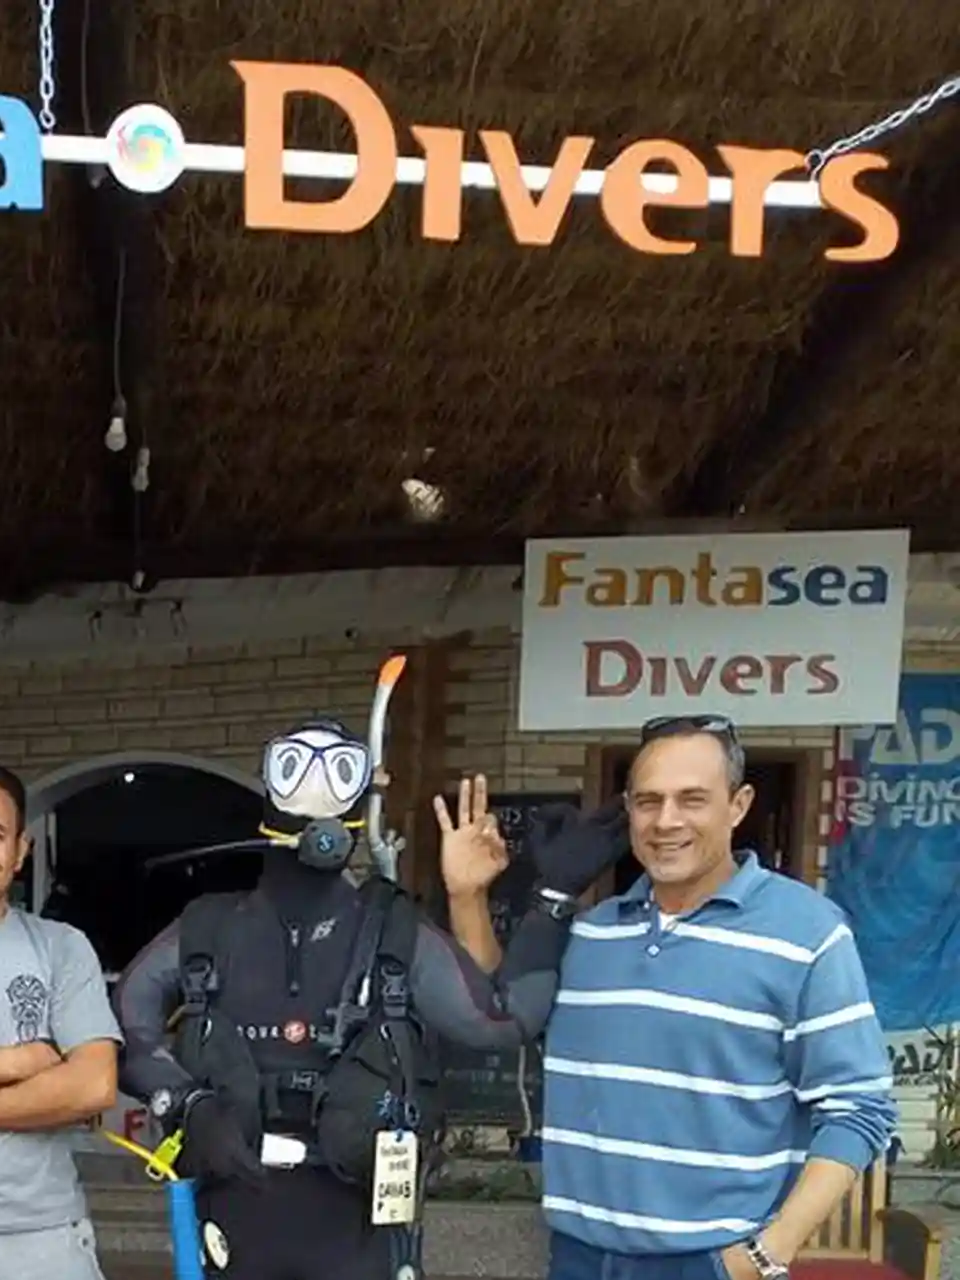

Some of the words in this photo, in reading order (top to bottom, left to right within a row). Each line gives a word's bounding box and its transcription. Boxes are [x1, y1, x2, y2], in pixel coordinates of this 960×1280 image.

[230, 60, 899, 262] Divers
[539, 551, 888, 607] Fantasea
[583, 639, 839, 698] Divers
